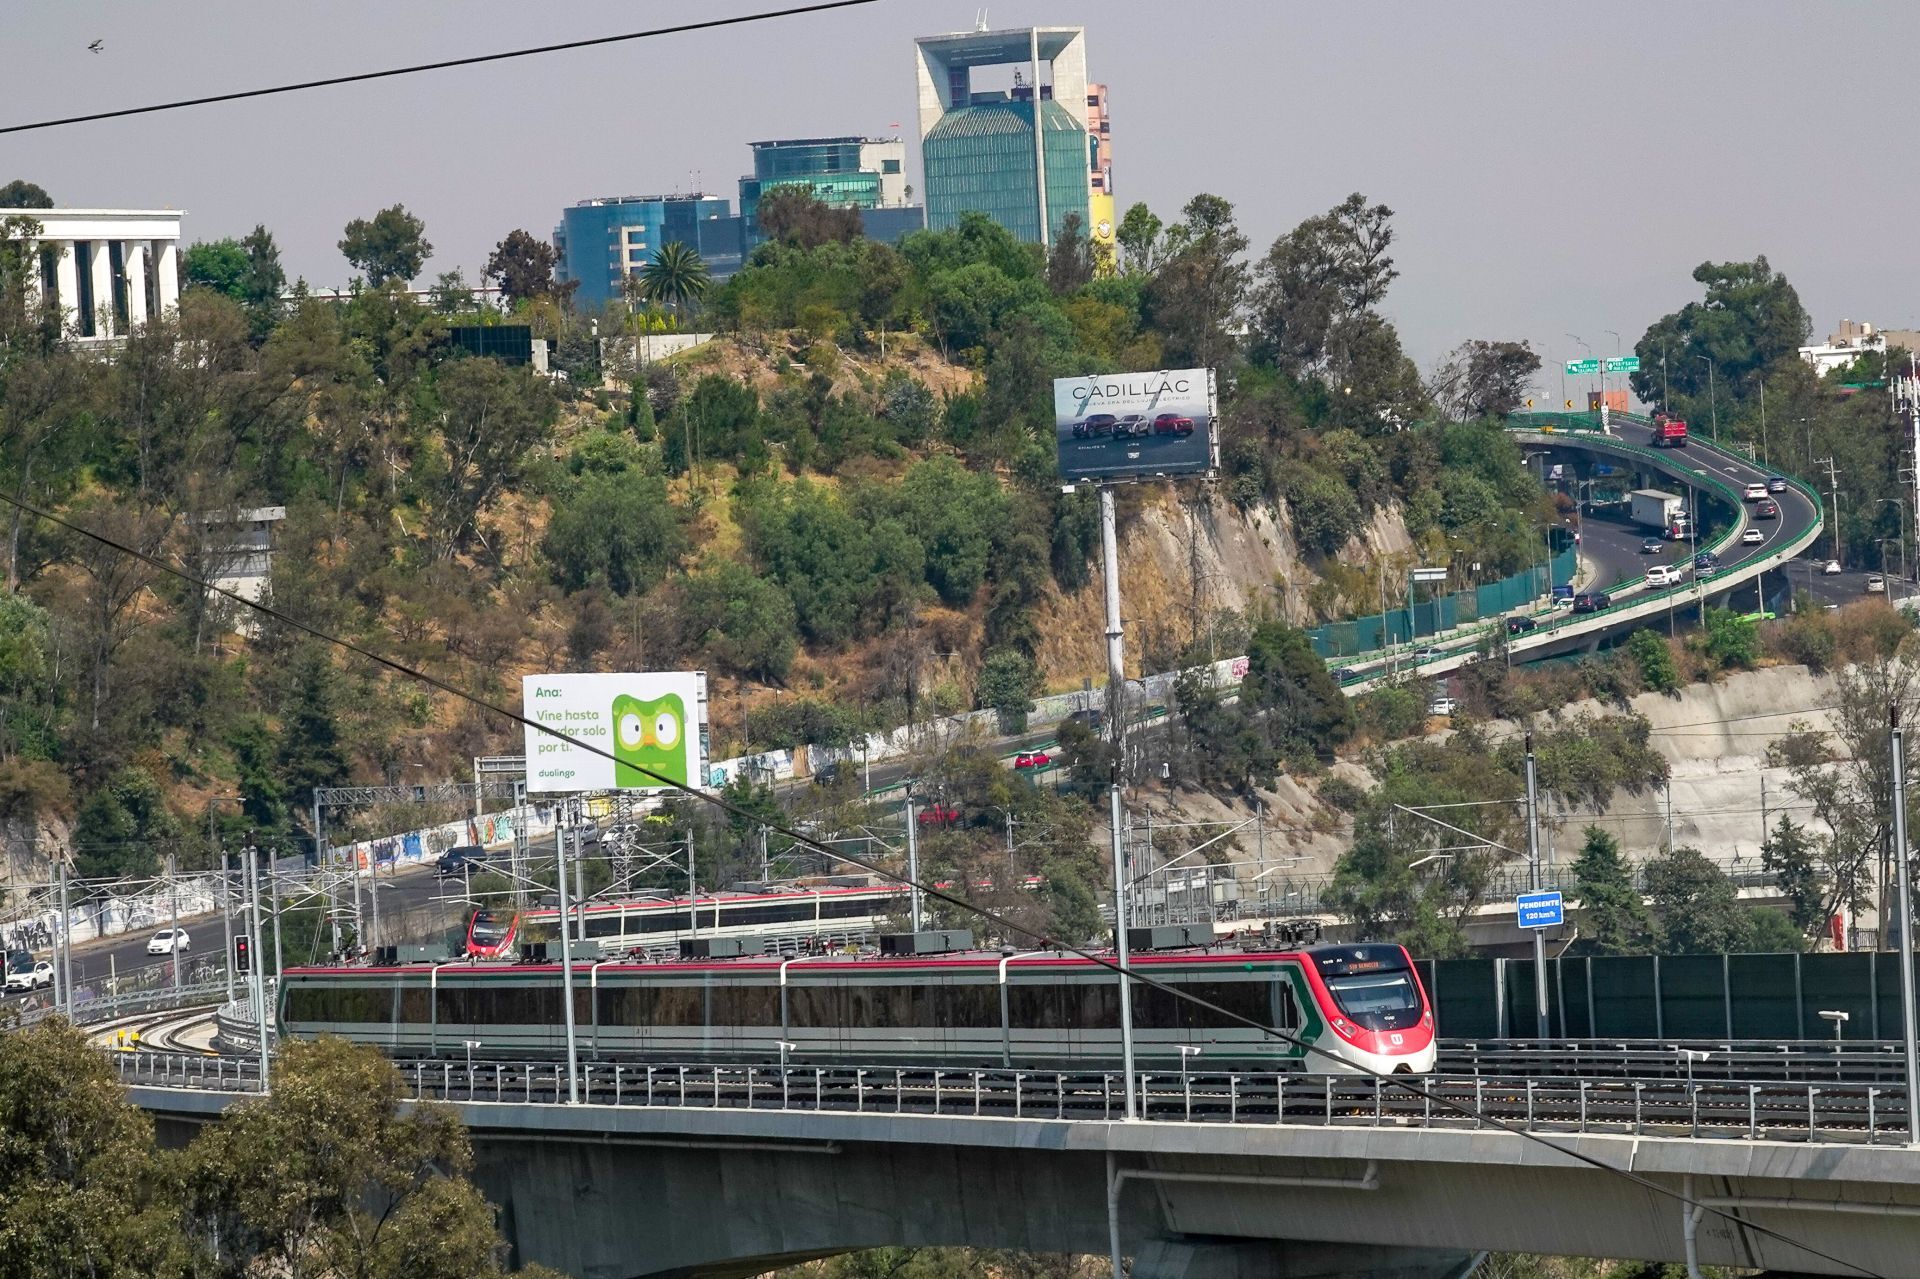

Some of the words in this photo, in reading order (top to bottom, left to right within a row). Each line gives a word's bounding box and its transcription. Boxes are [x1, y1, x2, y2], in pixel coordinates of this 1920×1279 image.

[1072, 380, 1189, 399] CADILLAC
[535, 687, 562, 697] Ana:
[536, 710, 562, 720] Vine
[565, 708, 599, 720] hasta
[583, 724, 606, 735] solo
[538, 743, 558, 755] por
[561, 741, 572, 752] ti.
[538, 769, 575, 778] duolingo
[1520, 900, 1560, 910] PENDIENTE
